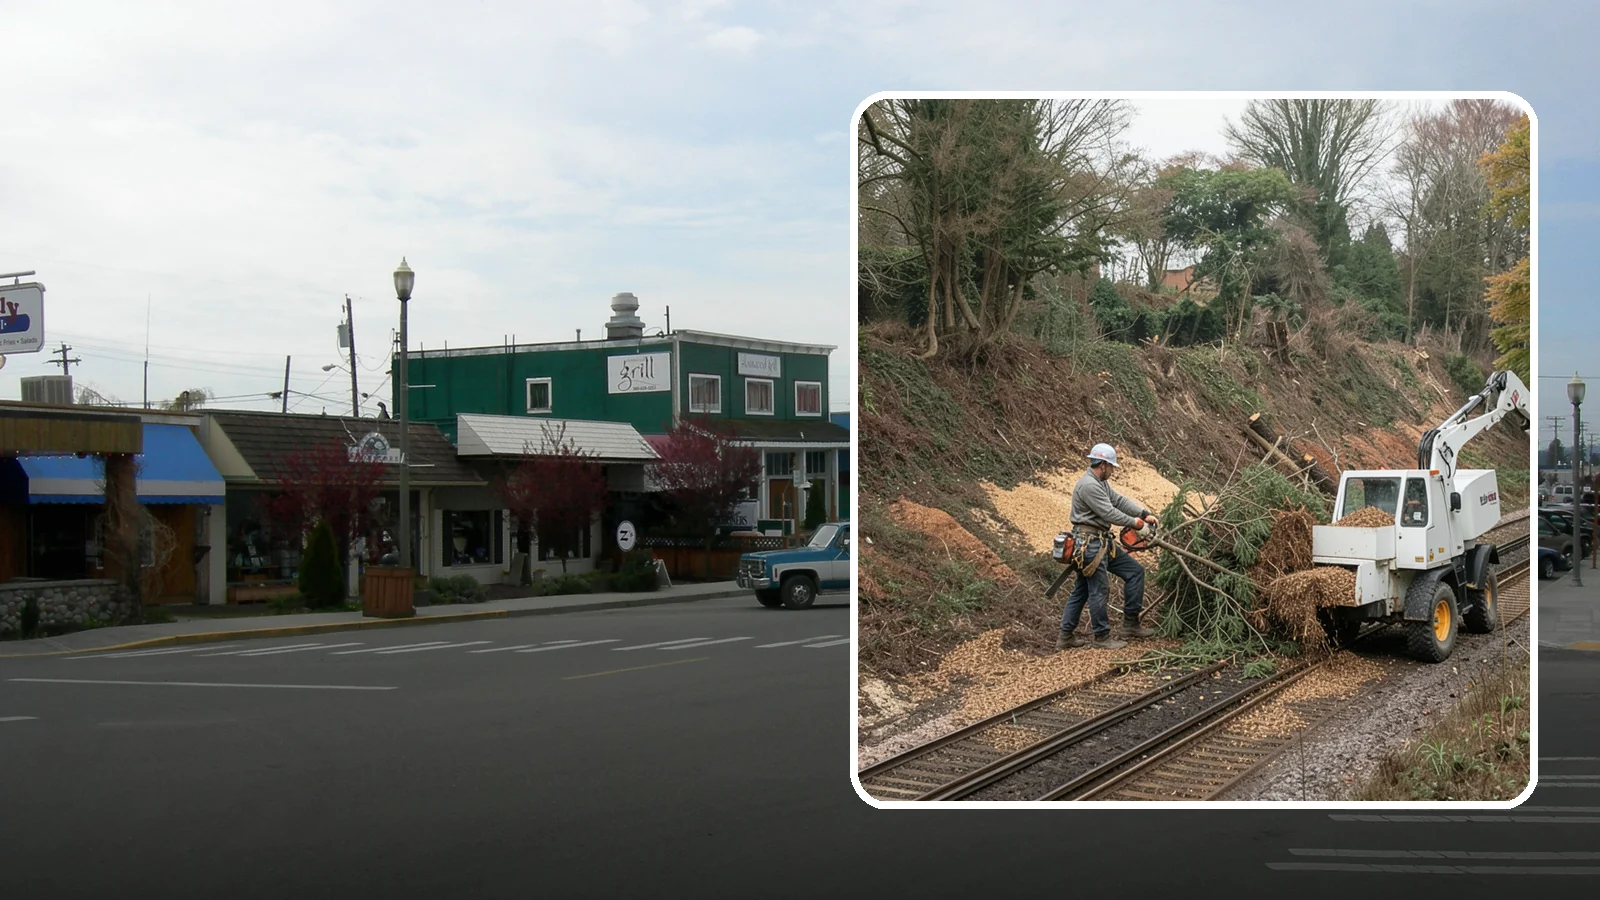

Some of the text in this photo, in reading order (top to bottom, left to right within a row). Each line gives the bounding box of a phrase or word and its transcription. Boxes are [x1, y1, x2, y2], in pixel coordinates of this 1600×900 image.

[3, 338, 16, 346] Fries
[20, 336, 38, 345] Salads
[617, 356, 655, 392] grill
